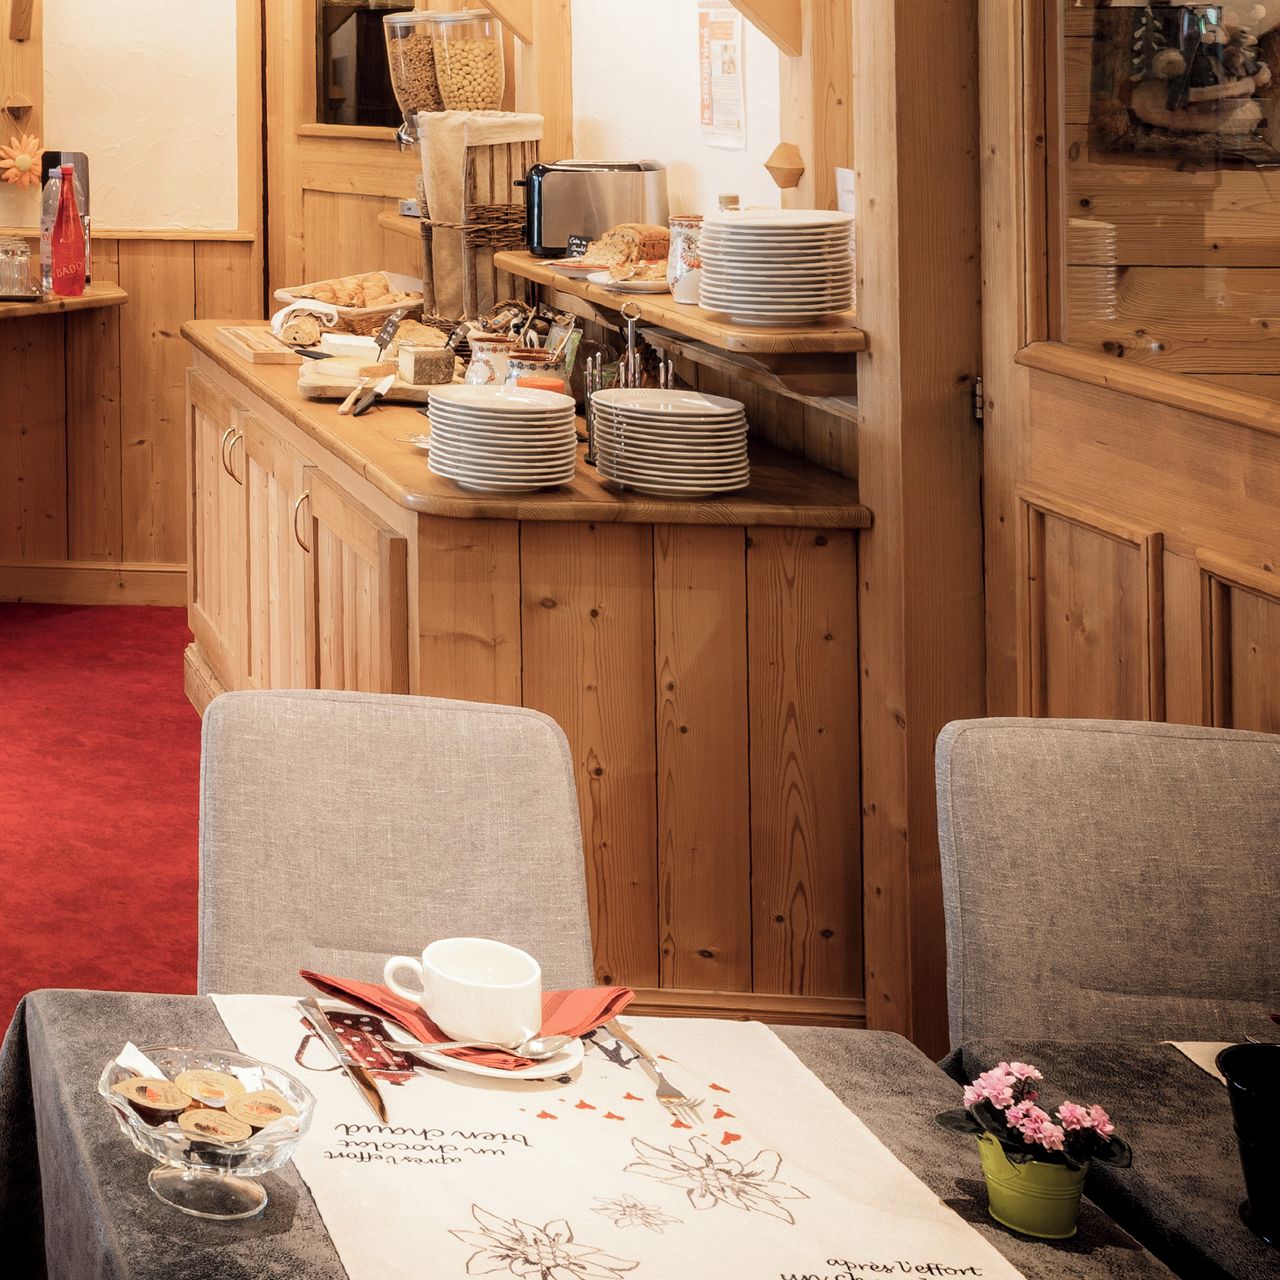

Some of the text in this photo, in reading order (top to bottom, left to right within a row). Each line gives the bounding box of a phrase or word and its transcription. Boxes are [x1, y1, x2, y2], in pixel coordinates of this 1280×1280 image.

[700, 25, 711, 104] dauphiné
[55, 258, 86, 277] BADO
[334, 1123, 534, 1148] bien chaud
[338, 1139, 506, 1156] un chocolat
[401, 1153, 462, 1165] après
[826, 1258, 894, 1274] après
